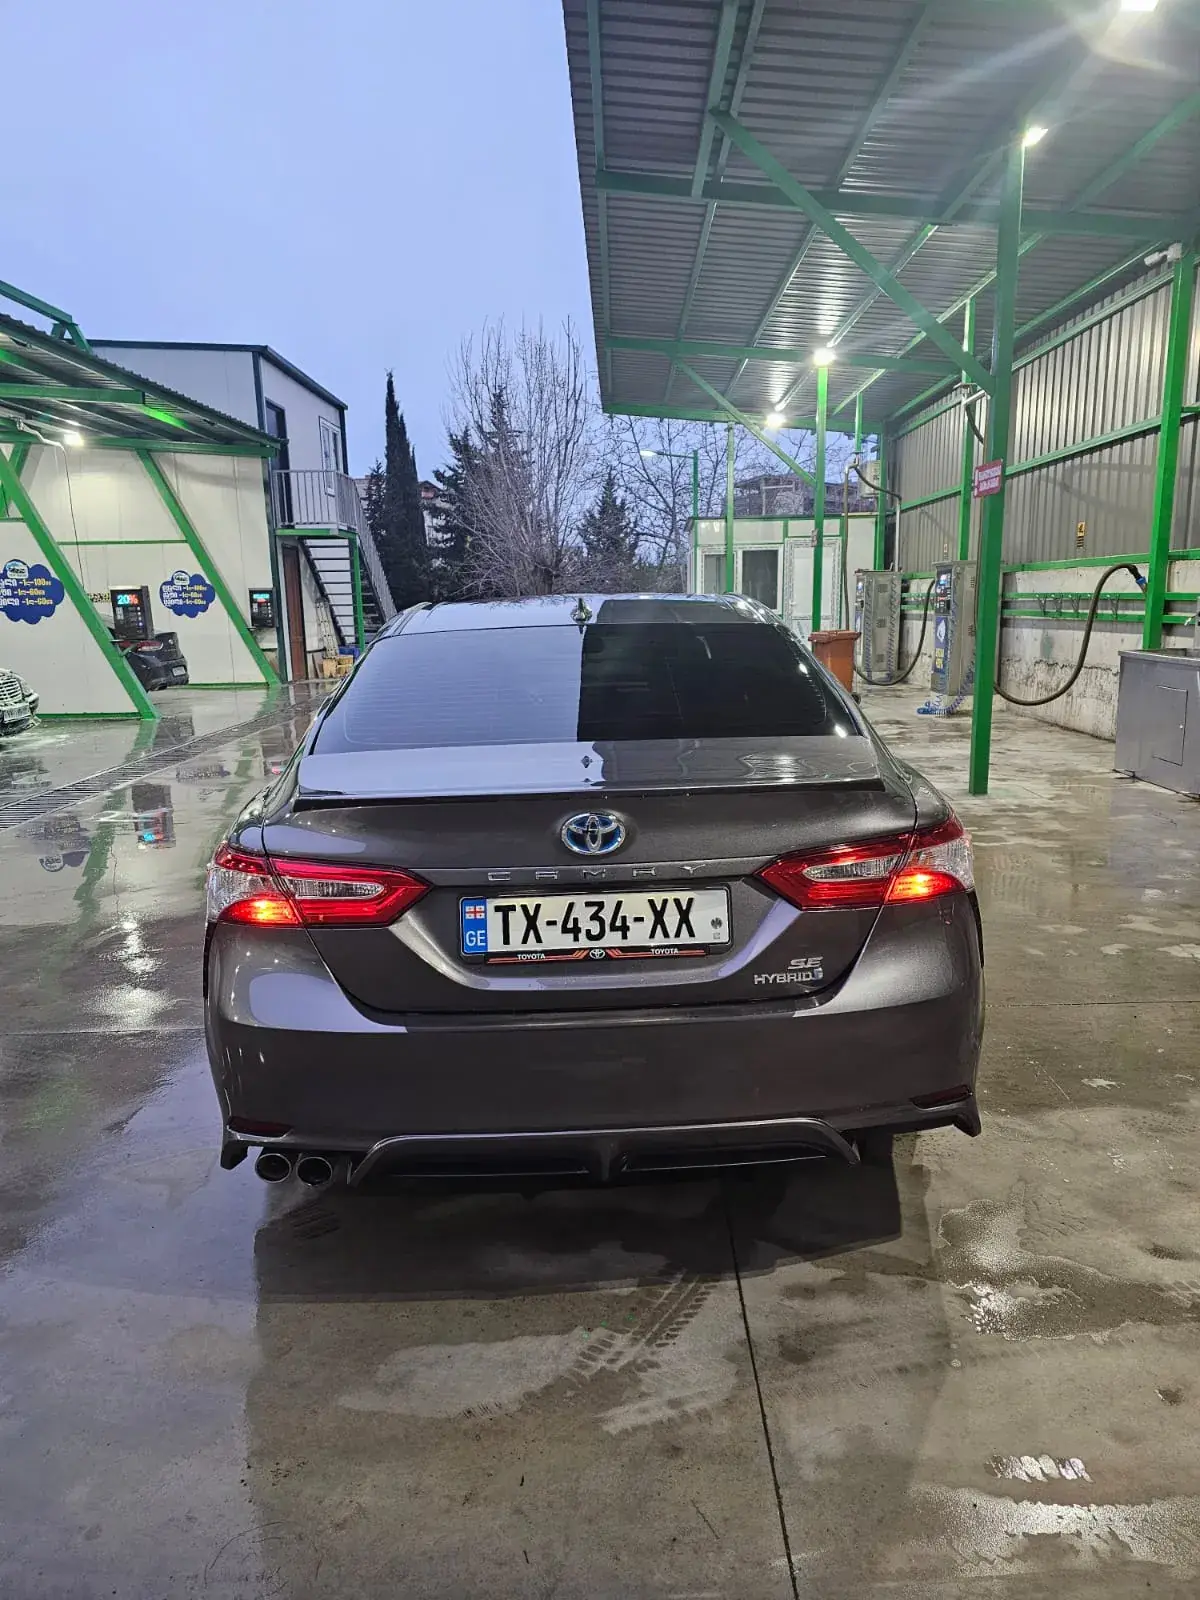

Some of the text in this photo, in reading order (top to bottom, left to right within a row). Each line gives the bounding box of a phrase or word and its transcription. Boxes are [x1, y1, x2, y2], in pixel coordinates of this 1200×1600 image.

[487, 863, 706, 881] CAMRY
[494, 897, 696, 946] TX-434-XX
[465, 930, 486, 947] GE
[517, 953, 546, 961] TOYOTA
[650, 947, 680, 956] TOYOTA
[787, 956, 824, 970] SE
[753, 971, 813, 985] HYBRID
